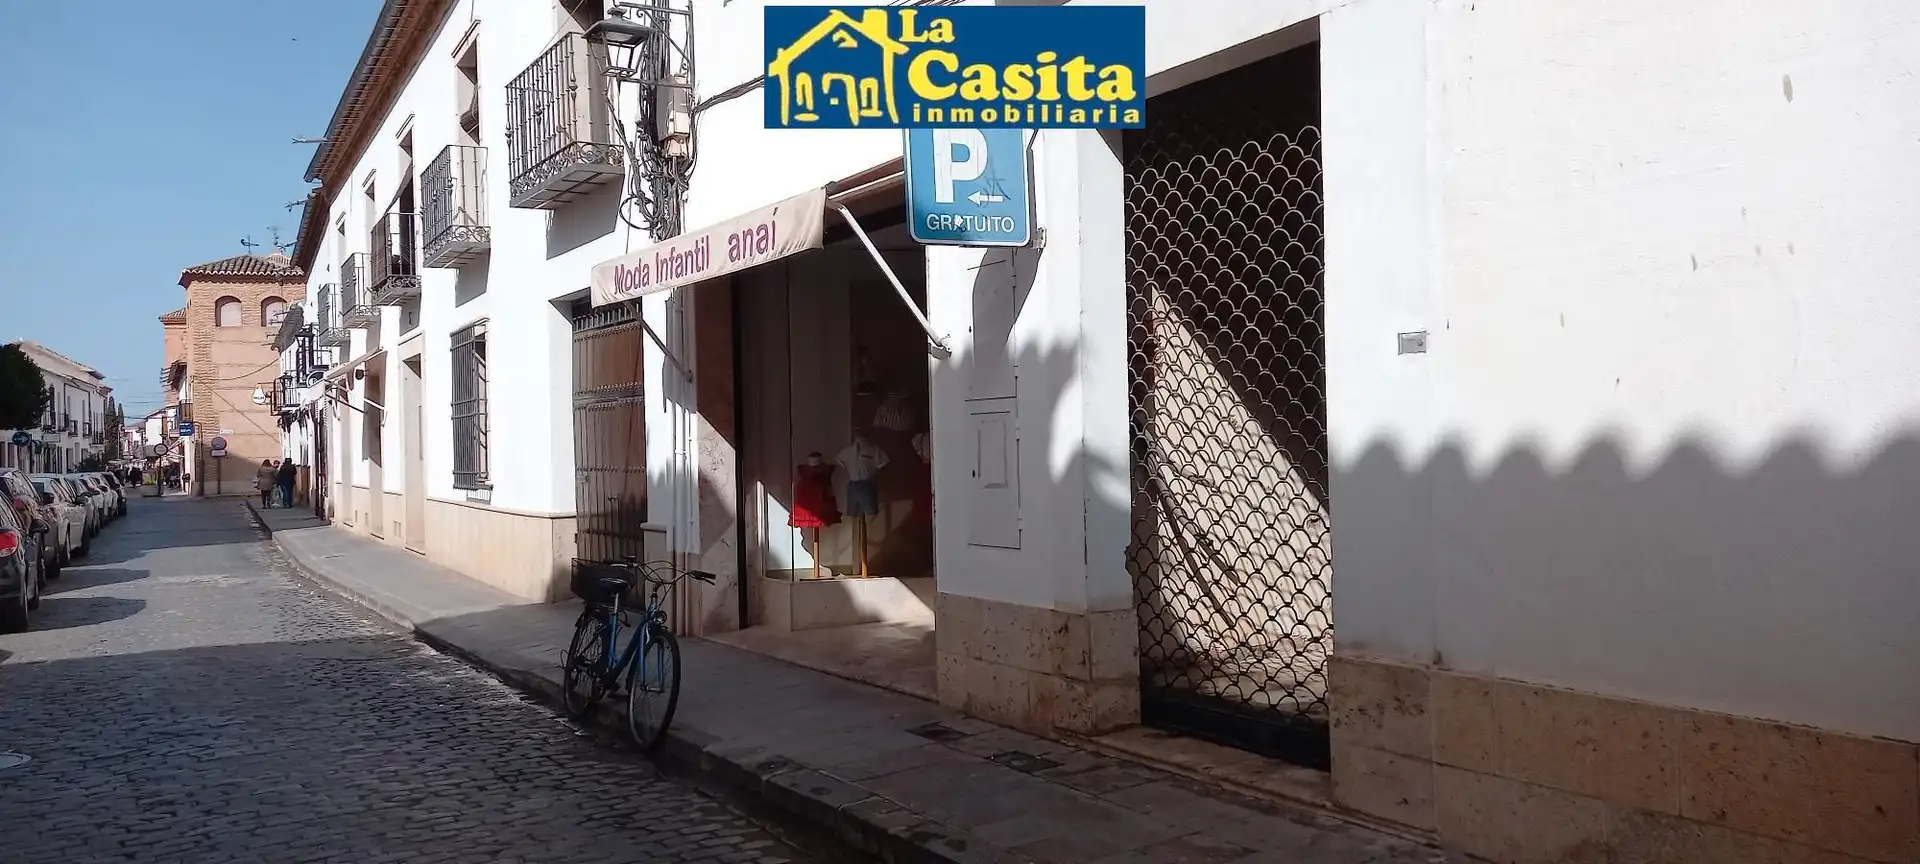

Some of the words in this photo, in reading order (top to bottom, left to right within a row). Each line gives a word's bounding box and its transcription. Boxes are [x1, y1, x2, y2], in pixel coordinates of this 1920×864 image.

[932, 128, 988, 203] P
[614, 256, 650, 295] Moda
[655, 233, 710, 285] Infantil
[727, 206, 776, 264] anaí
[926, 213, 1015, 233] GRATUITO
